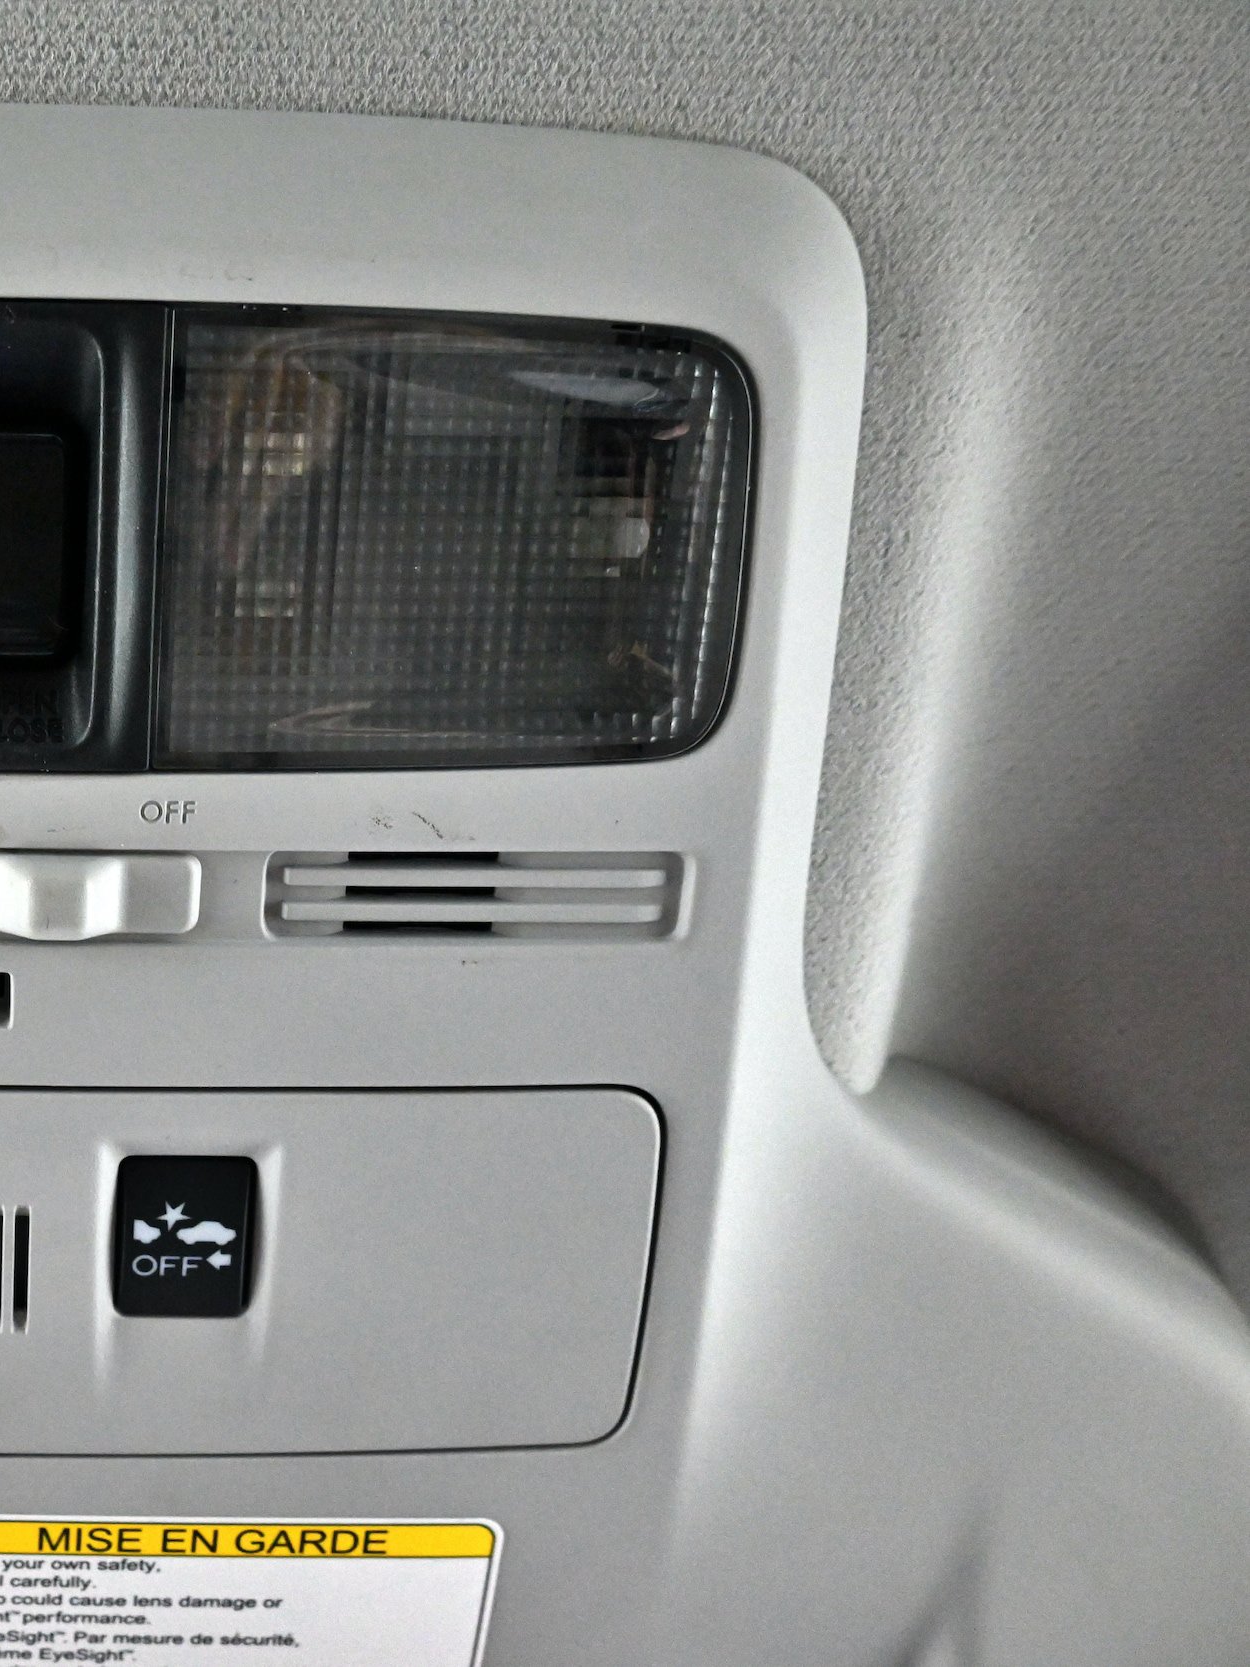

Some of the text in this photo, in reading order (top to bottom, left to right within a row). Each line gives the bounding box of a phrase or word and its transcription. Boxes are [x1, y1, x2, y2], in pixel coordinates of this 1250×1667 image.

[139, 799, 197, 824] OFF
[131, 1254, 206, 1277] OFF
[37, 1527, 142, 1553] MISE
[161, 1528, 218, 1554] EN
[235, 1529, 388, 1556] GARDE
[2, 1559, 45, 1571] your
[51, 1560, 90, 1570] own
[10, 1576, 96, 1590] carefully.
[11, 1594, 63, 1606] could
[70, 1595, 126, 1607] cause
[133, 1595, 172, 1607] lens
[179, 1596, 257, 1610] damage
[263, 1599, 283, 1608] or
[74, 1631, 107, 1644] Par
[113, 1634, 184, 1645] mesure
[190, 1634, 213, 1645] de
